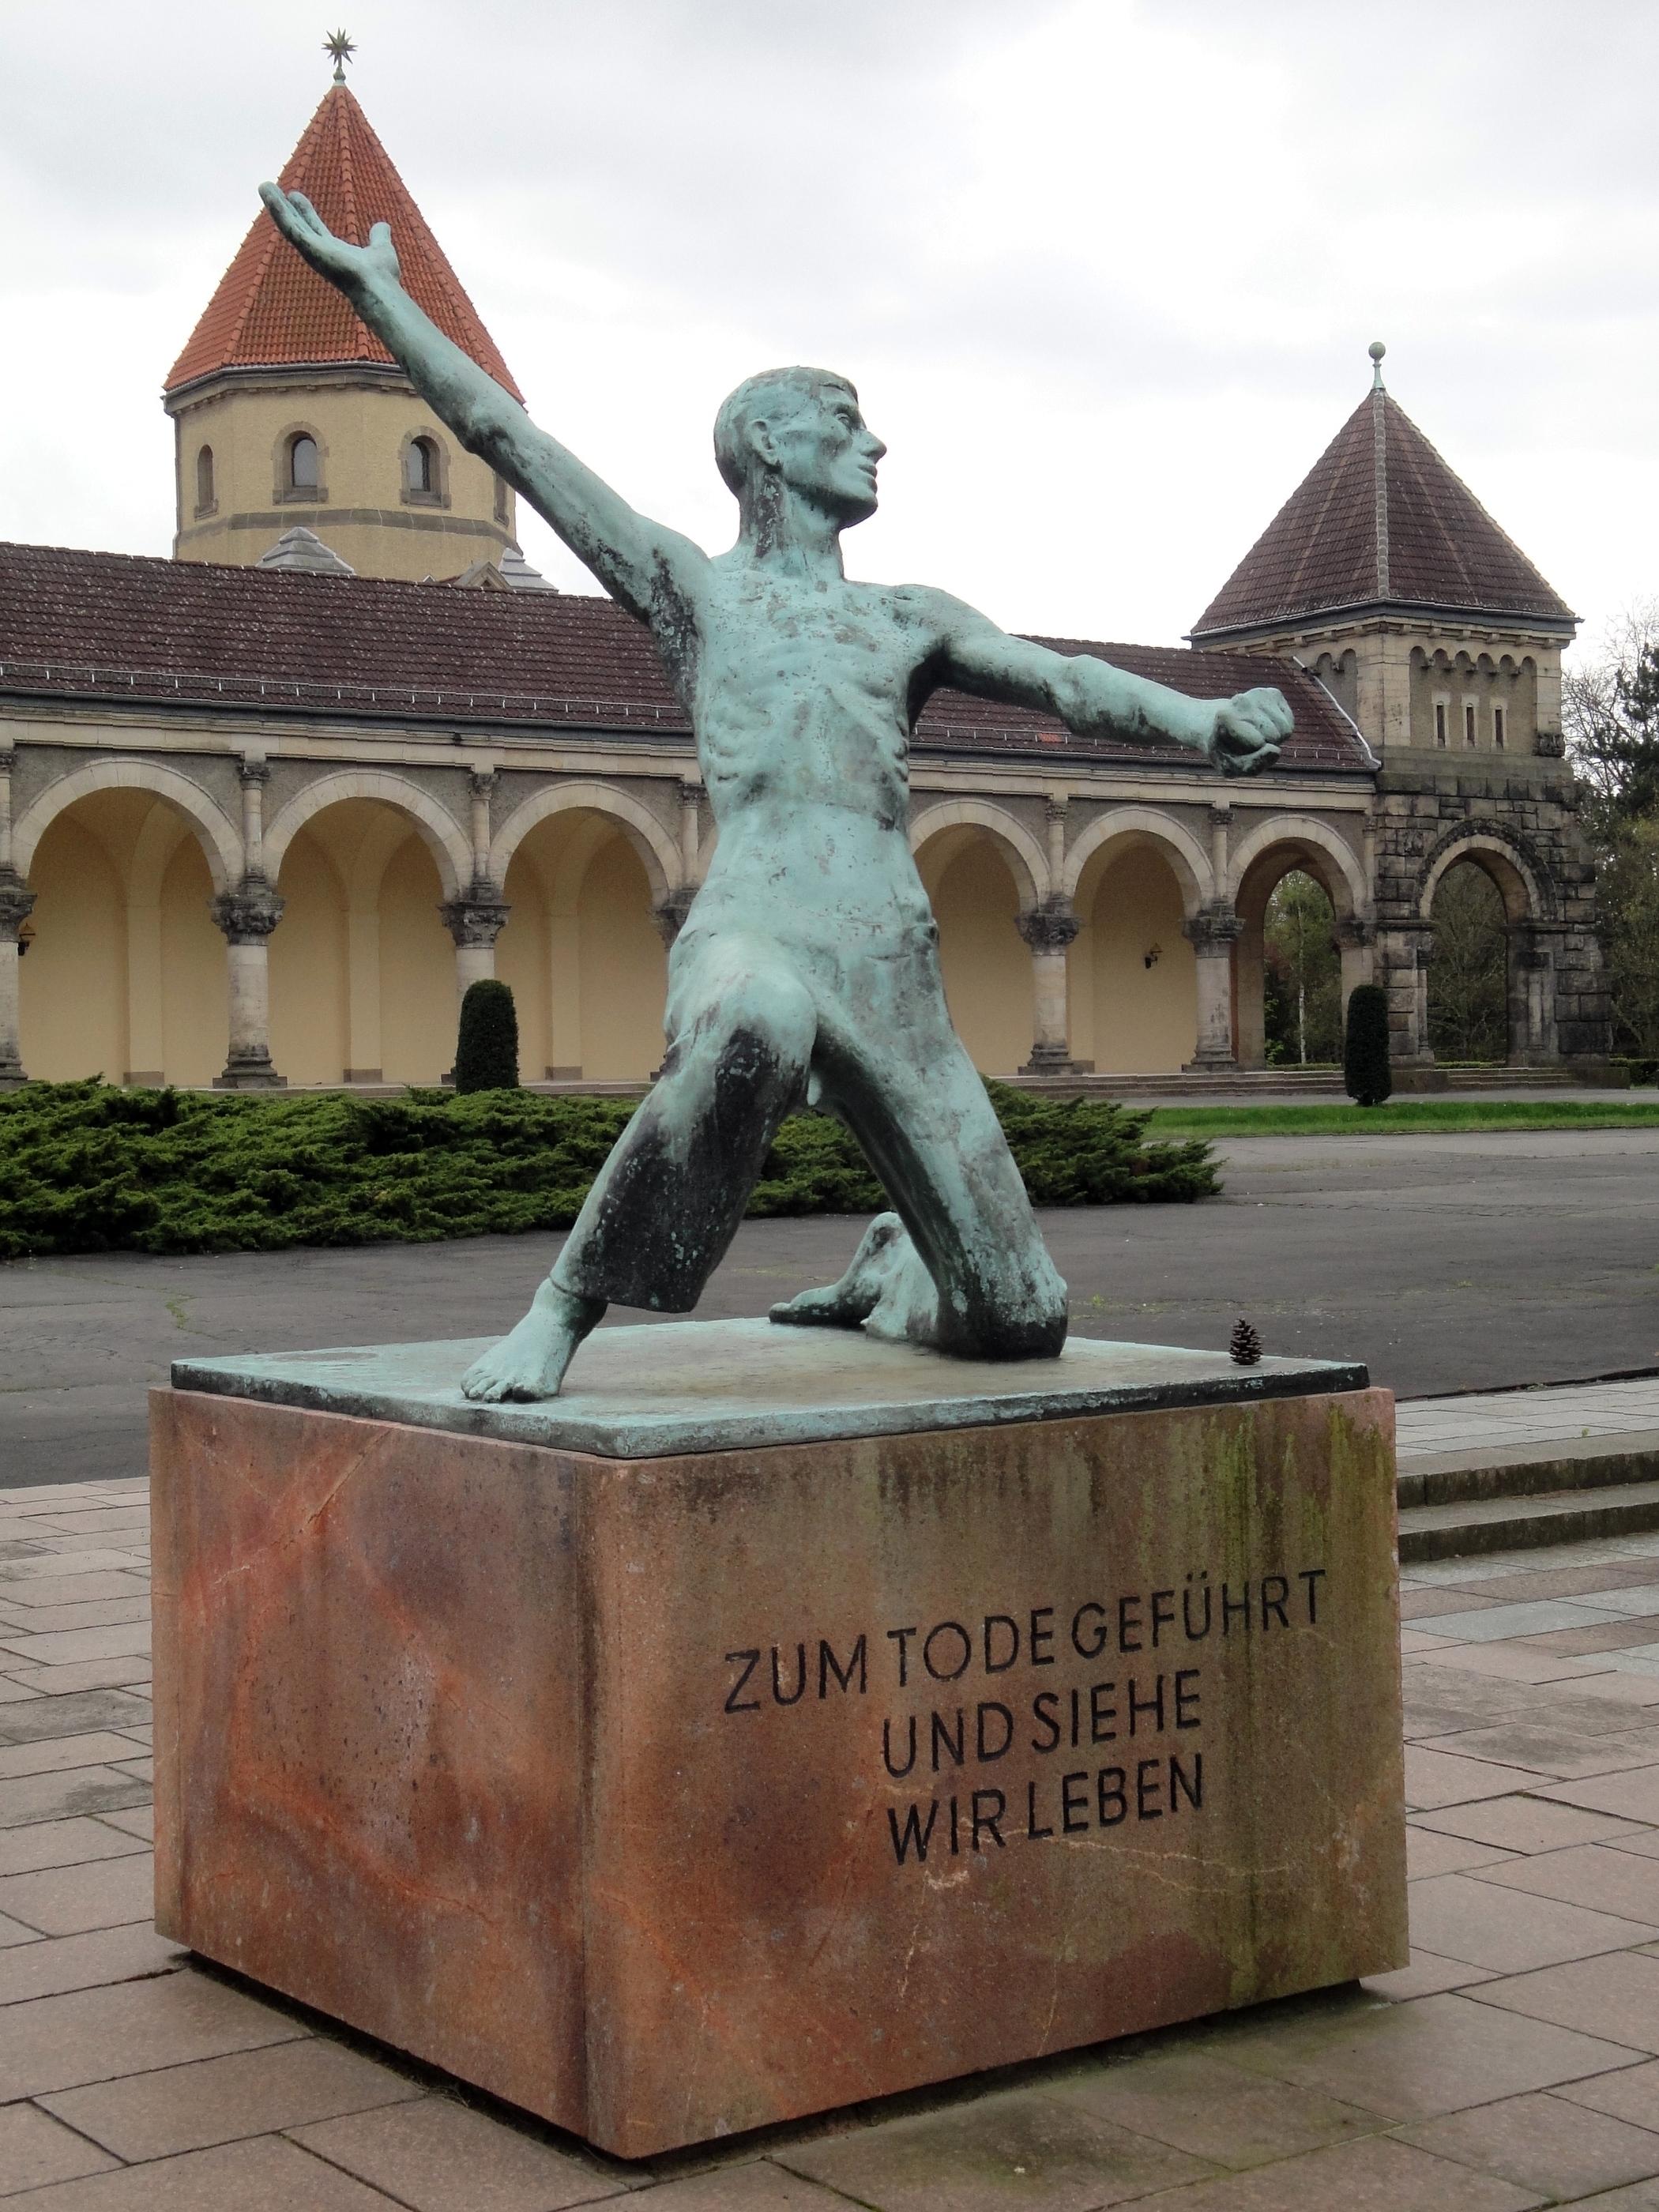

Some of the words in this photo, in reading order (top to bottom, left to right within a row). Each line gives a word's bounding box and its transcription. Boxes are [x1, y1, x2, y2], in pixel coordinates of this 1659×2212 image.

[724, 1635, 868, 1715] ZUM
[886, 1607, 1055, 1688] TODE
[1070, 1569, 1327, 1660] GEFÜHRT
[882, 1701, 1014, 1779] UND
[1031, 1668, 1202, 1755] SIEHE
[886, 1788, 1007, 1866] WIR
[1027, 1752, 1204, 1841] LEBEN
